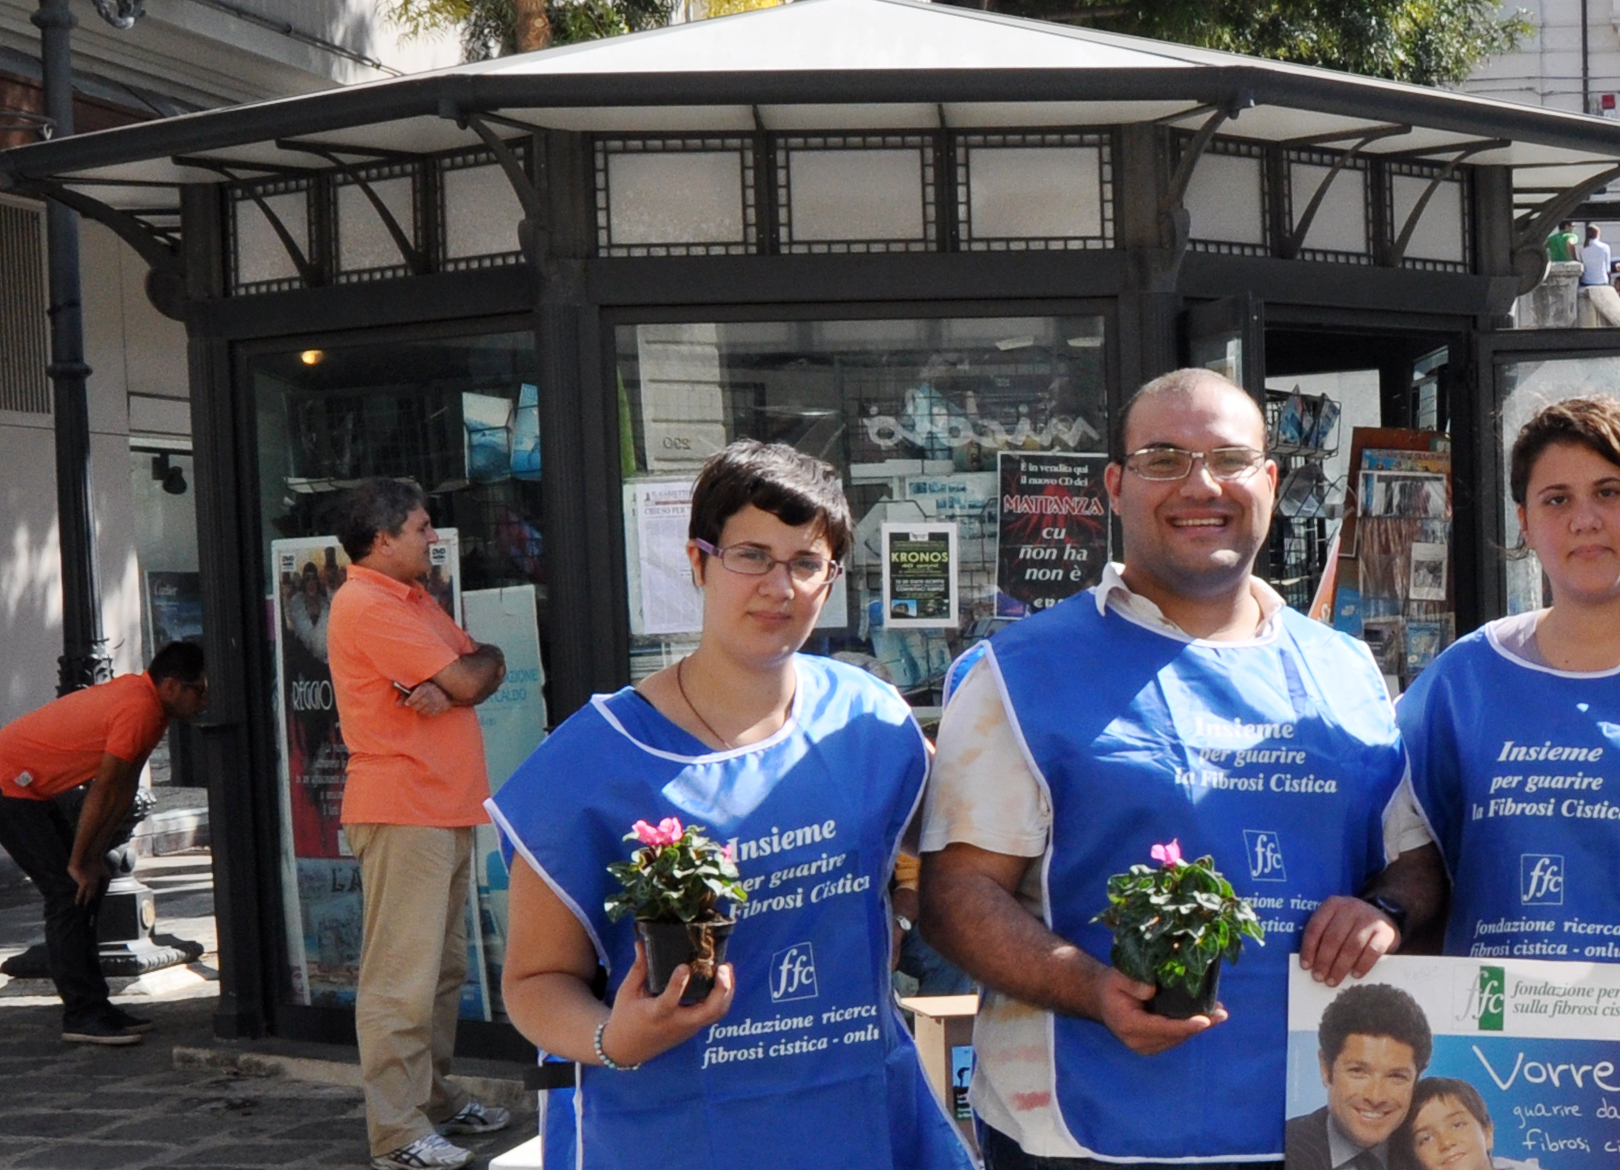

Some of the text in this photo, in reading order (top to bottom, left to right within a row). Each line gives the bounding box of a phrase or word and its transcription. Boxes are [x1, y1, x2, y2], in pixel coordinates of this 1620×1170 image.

[1028, 463, 1038, 472] in
[1039, 463, 1072, 473] vendita
[1073, 465, 1089, 475] qui
[1020, 476, 1088, 486] il nuovo CD dei
[1003, 494, 1105, 516] MATTANZA
[1042, 527, 1066, 539] cu
[891, 551, 949, 562] KRONOS
[1018, 543, 1088, 561] non ha
[1024, 565, 1082, 581] non è
[1195, 717, 1294, 739] Insieme
[1199, 747, 1306, 767] per guarire
[1497, 741, 1603, 762] Insieme
[1200, 770, 1264, 791] Fibrosi
[1270, 772, 1338, 794] Cistica
[1489, 772, 1604, 794] per guarire
[1472, 803, 1484, 821] la
[1487, 798, 1556, 819] Fibrosi
[1252, 834, 1283, 877] ffc
[769, 852, 846, 887] guarire
[1523, 857, 1562, 902] ffc
[1256, 916, 1295, 933] istica
[1473, 916, 1556, 938] fondazione
[1469, 939, 1510, 957] fibrosi
[1513, 939, 1567, 956] cistica
[773, 948, 814, 998] ffc
[1511, 980, 1594, 999] fondazione
[1512, 998, 1548, 1015] sulla
[1549, 1000, 1600, 1018] fibrosi
[706, 1013, 814, 1043] fondazione
[701, 1041, 764, 1069] fibrosi
[769, 1031, 828, 1057] cistica
[1513, 1101, 1583, 1129] guarire
[1522, 1128, 1591, 1153] fibrosi
